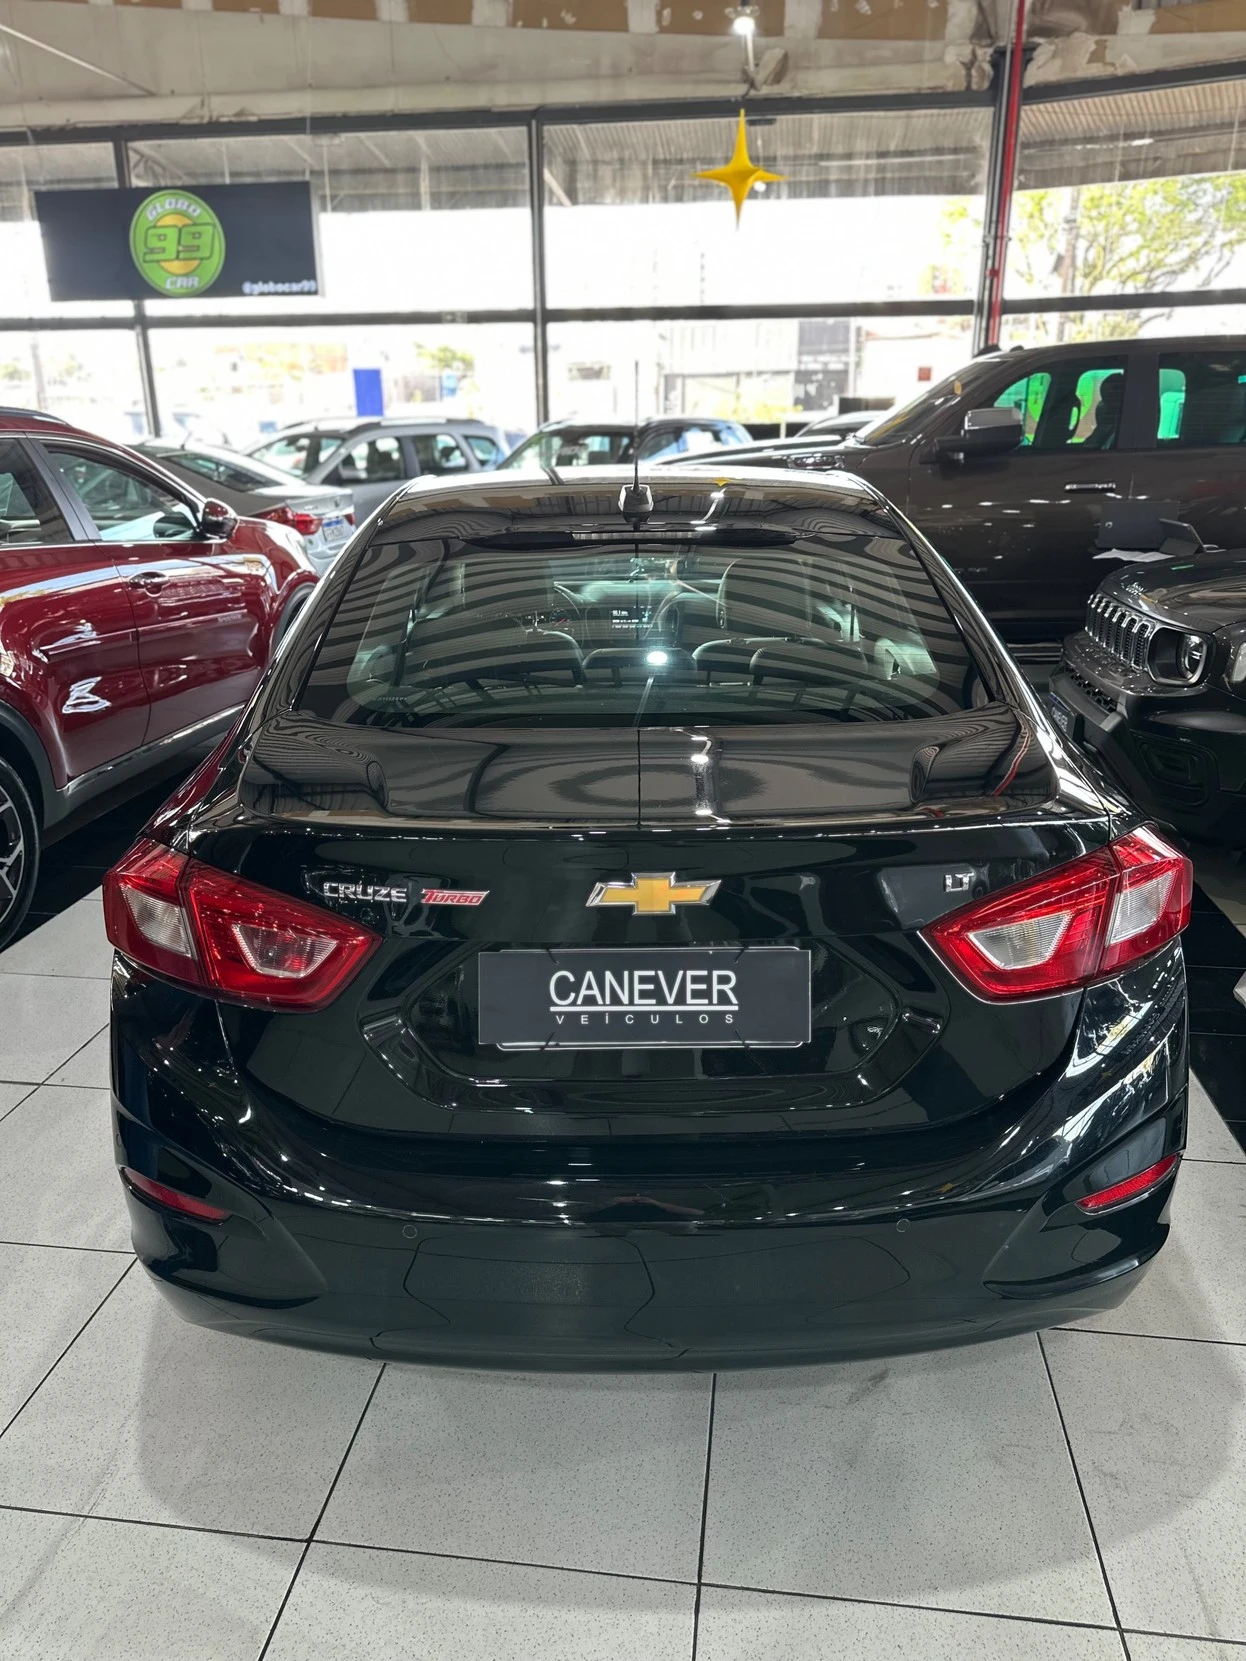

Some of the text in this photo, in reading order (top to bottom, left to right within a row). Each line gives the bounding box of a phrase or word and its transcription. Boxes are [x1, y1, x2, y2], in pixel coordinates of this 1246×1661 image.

[146, 198, 201, 220] GLOBO
[143, 223, 216, 263] 99
[165, 276, 200, 290] CAR
[323, 881, 407, 903] CRUZE
[944, 872, 975, 892] LT
[549, 970, 739, 1005] CANEVER
[555, 1012, 734, 1025] VEÍCULOS
